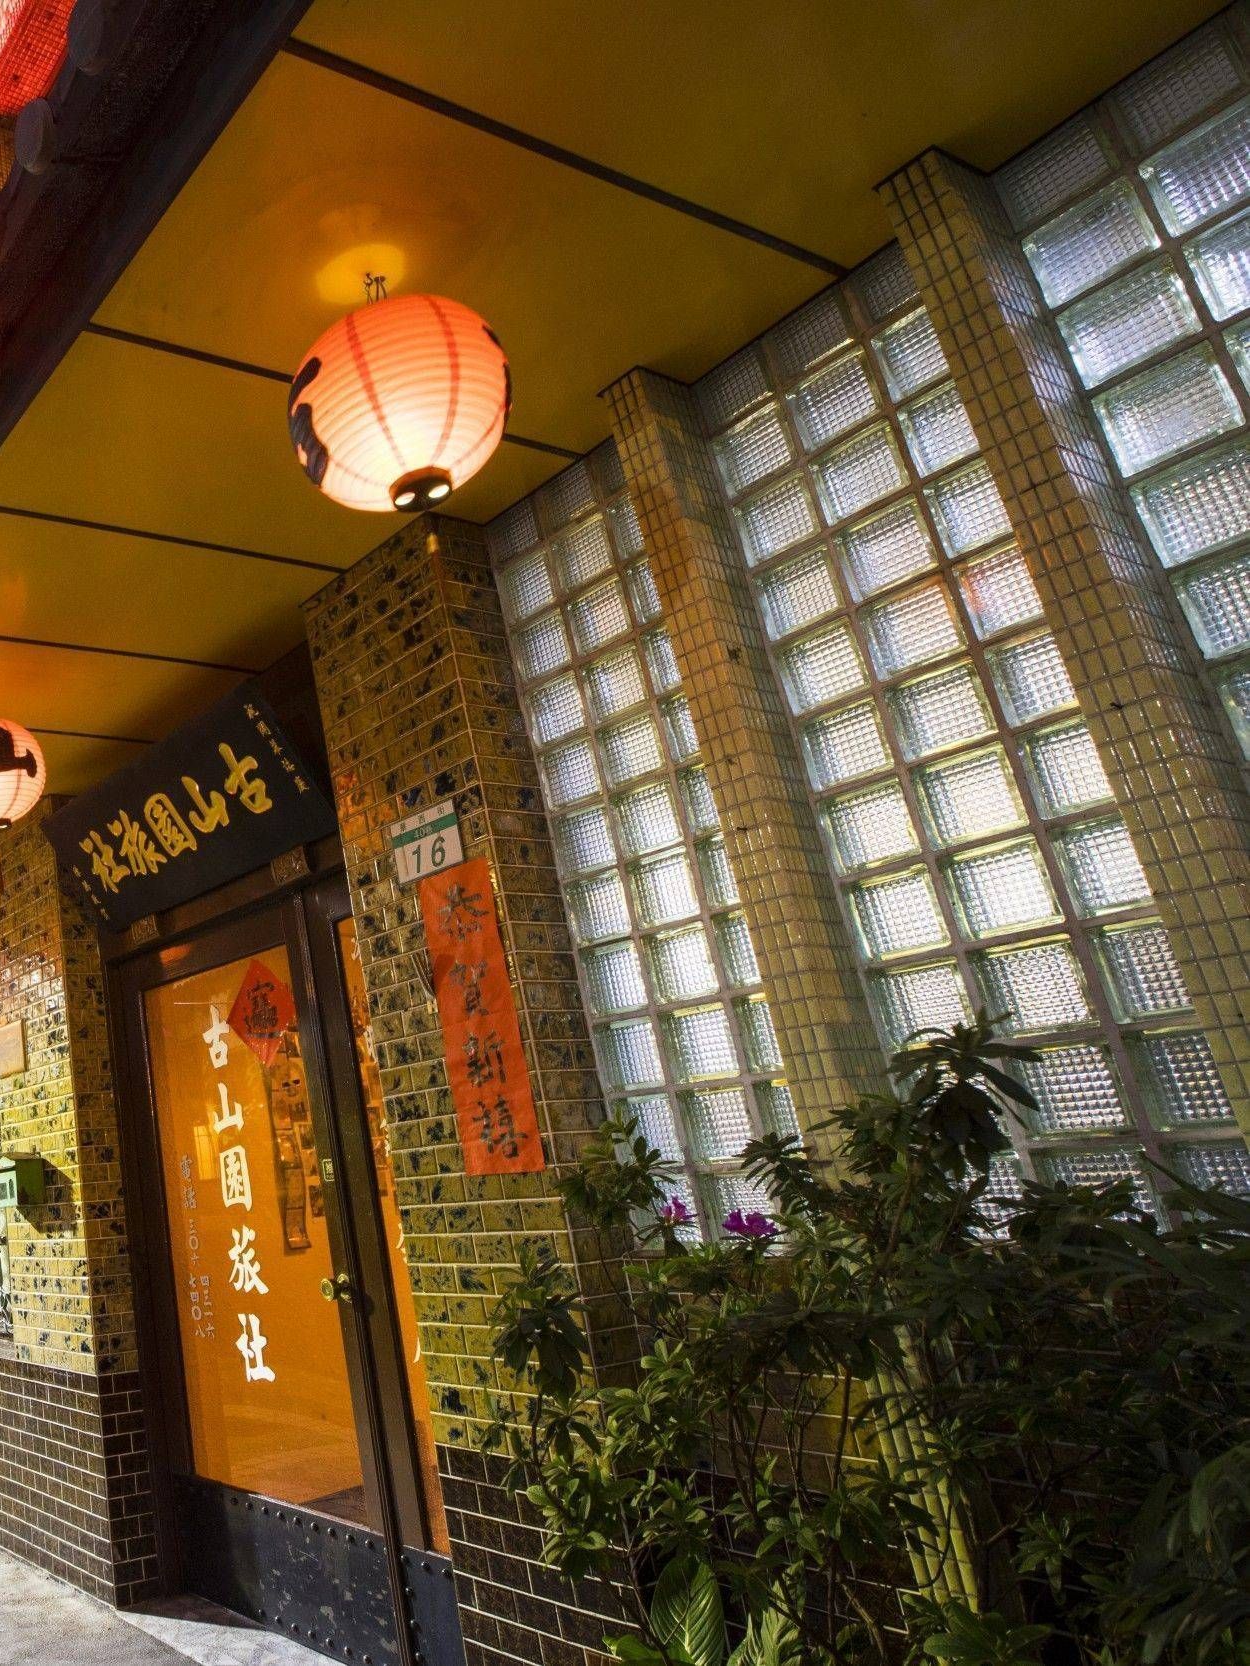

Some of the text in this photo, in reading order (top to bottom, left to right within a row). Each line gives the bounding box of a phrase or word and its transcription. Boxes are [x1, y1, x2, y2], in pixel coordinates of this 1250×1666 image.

[412, 836, 445, 873] 16
[438, 881, 528, 1159] 恭賀新禧
[202, 1005, 276, 1384] 古山園旅社
